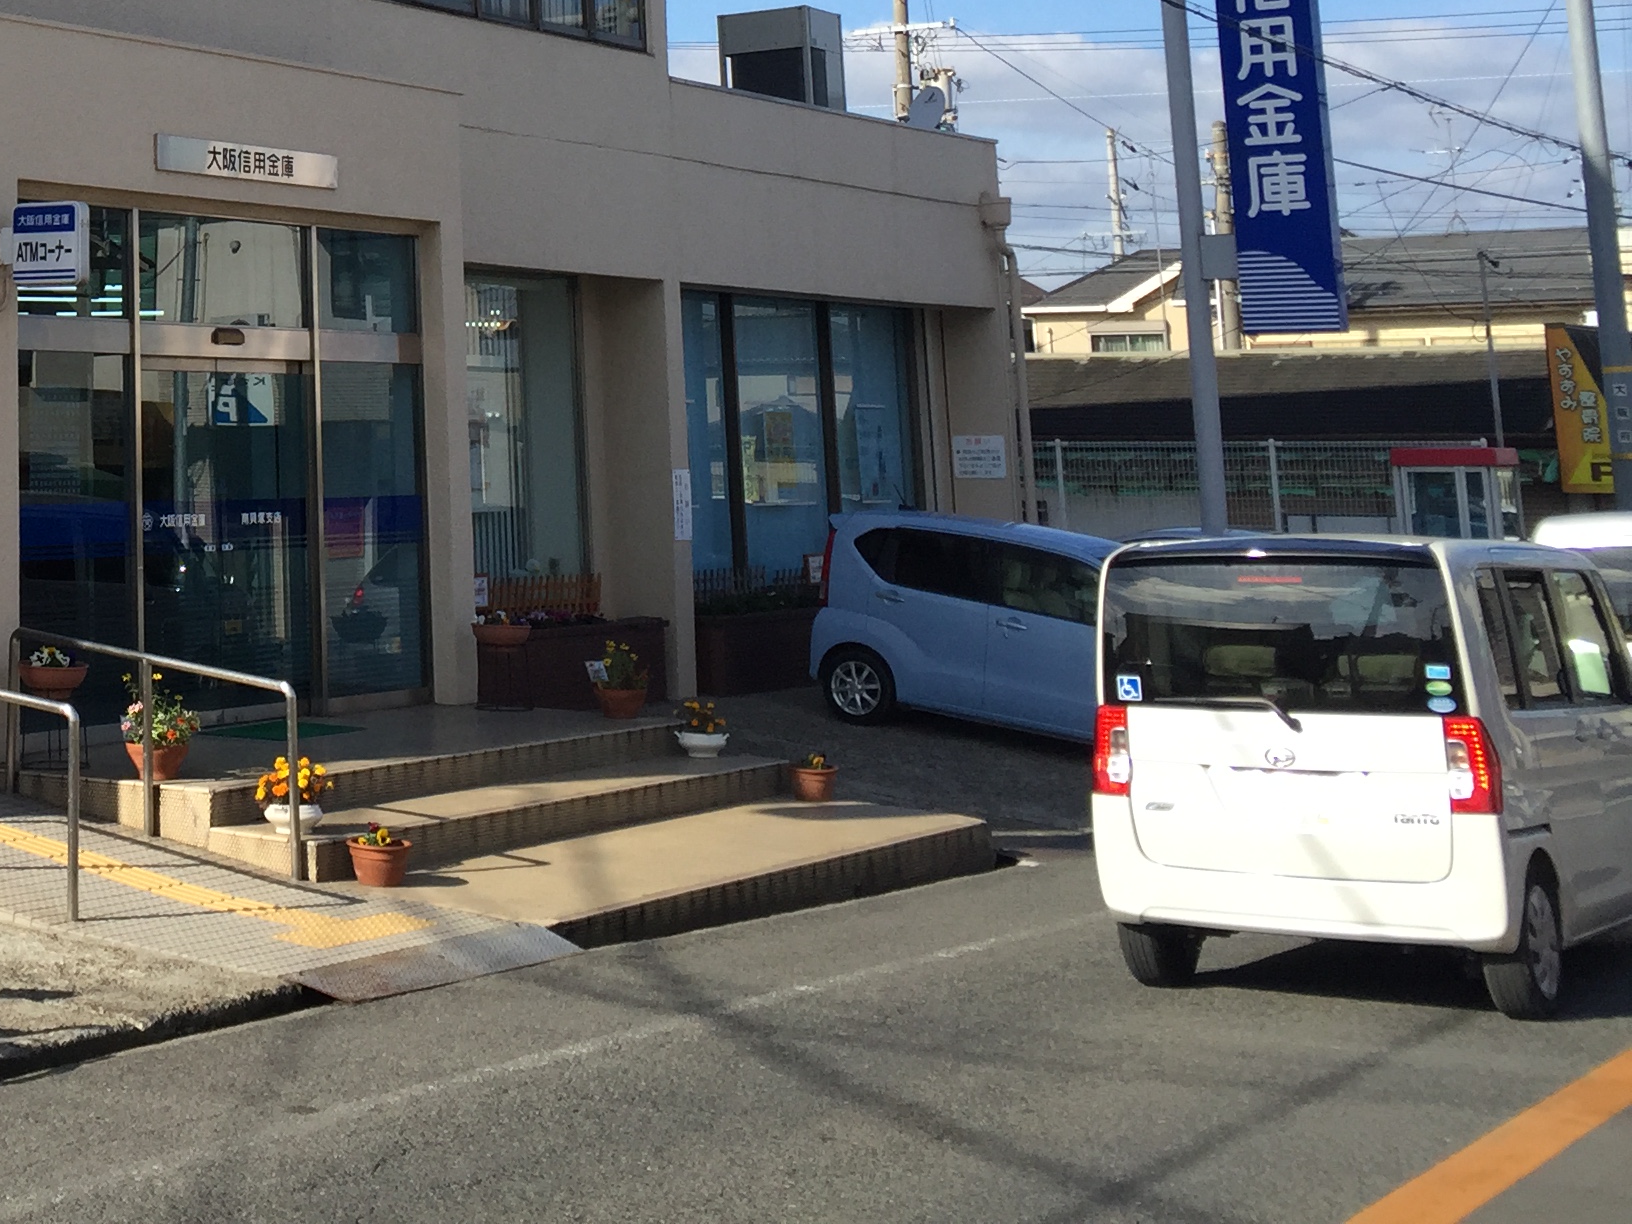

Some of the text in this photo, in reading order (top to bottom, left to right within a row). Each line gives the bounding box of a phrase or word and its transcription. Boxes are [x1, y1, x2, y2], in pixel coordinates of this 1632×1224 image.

[206, 146, 295, 179] 大阪信用金庫
[17, 213, 70, 226] 大阪信用金庫
[16, 239, 72, 262] ATMコーナー
